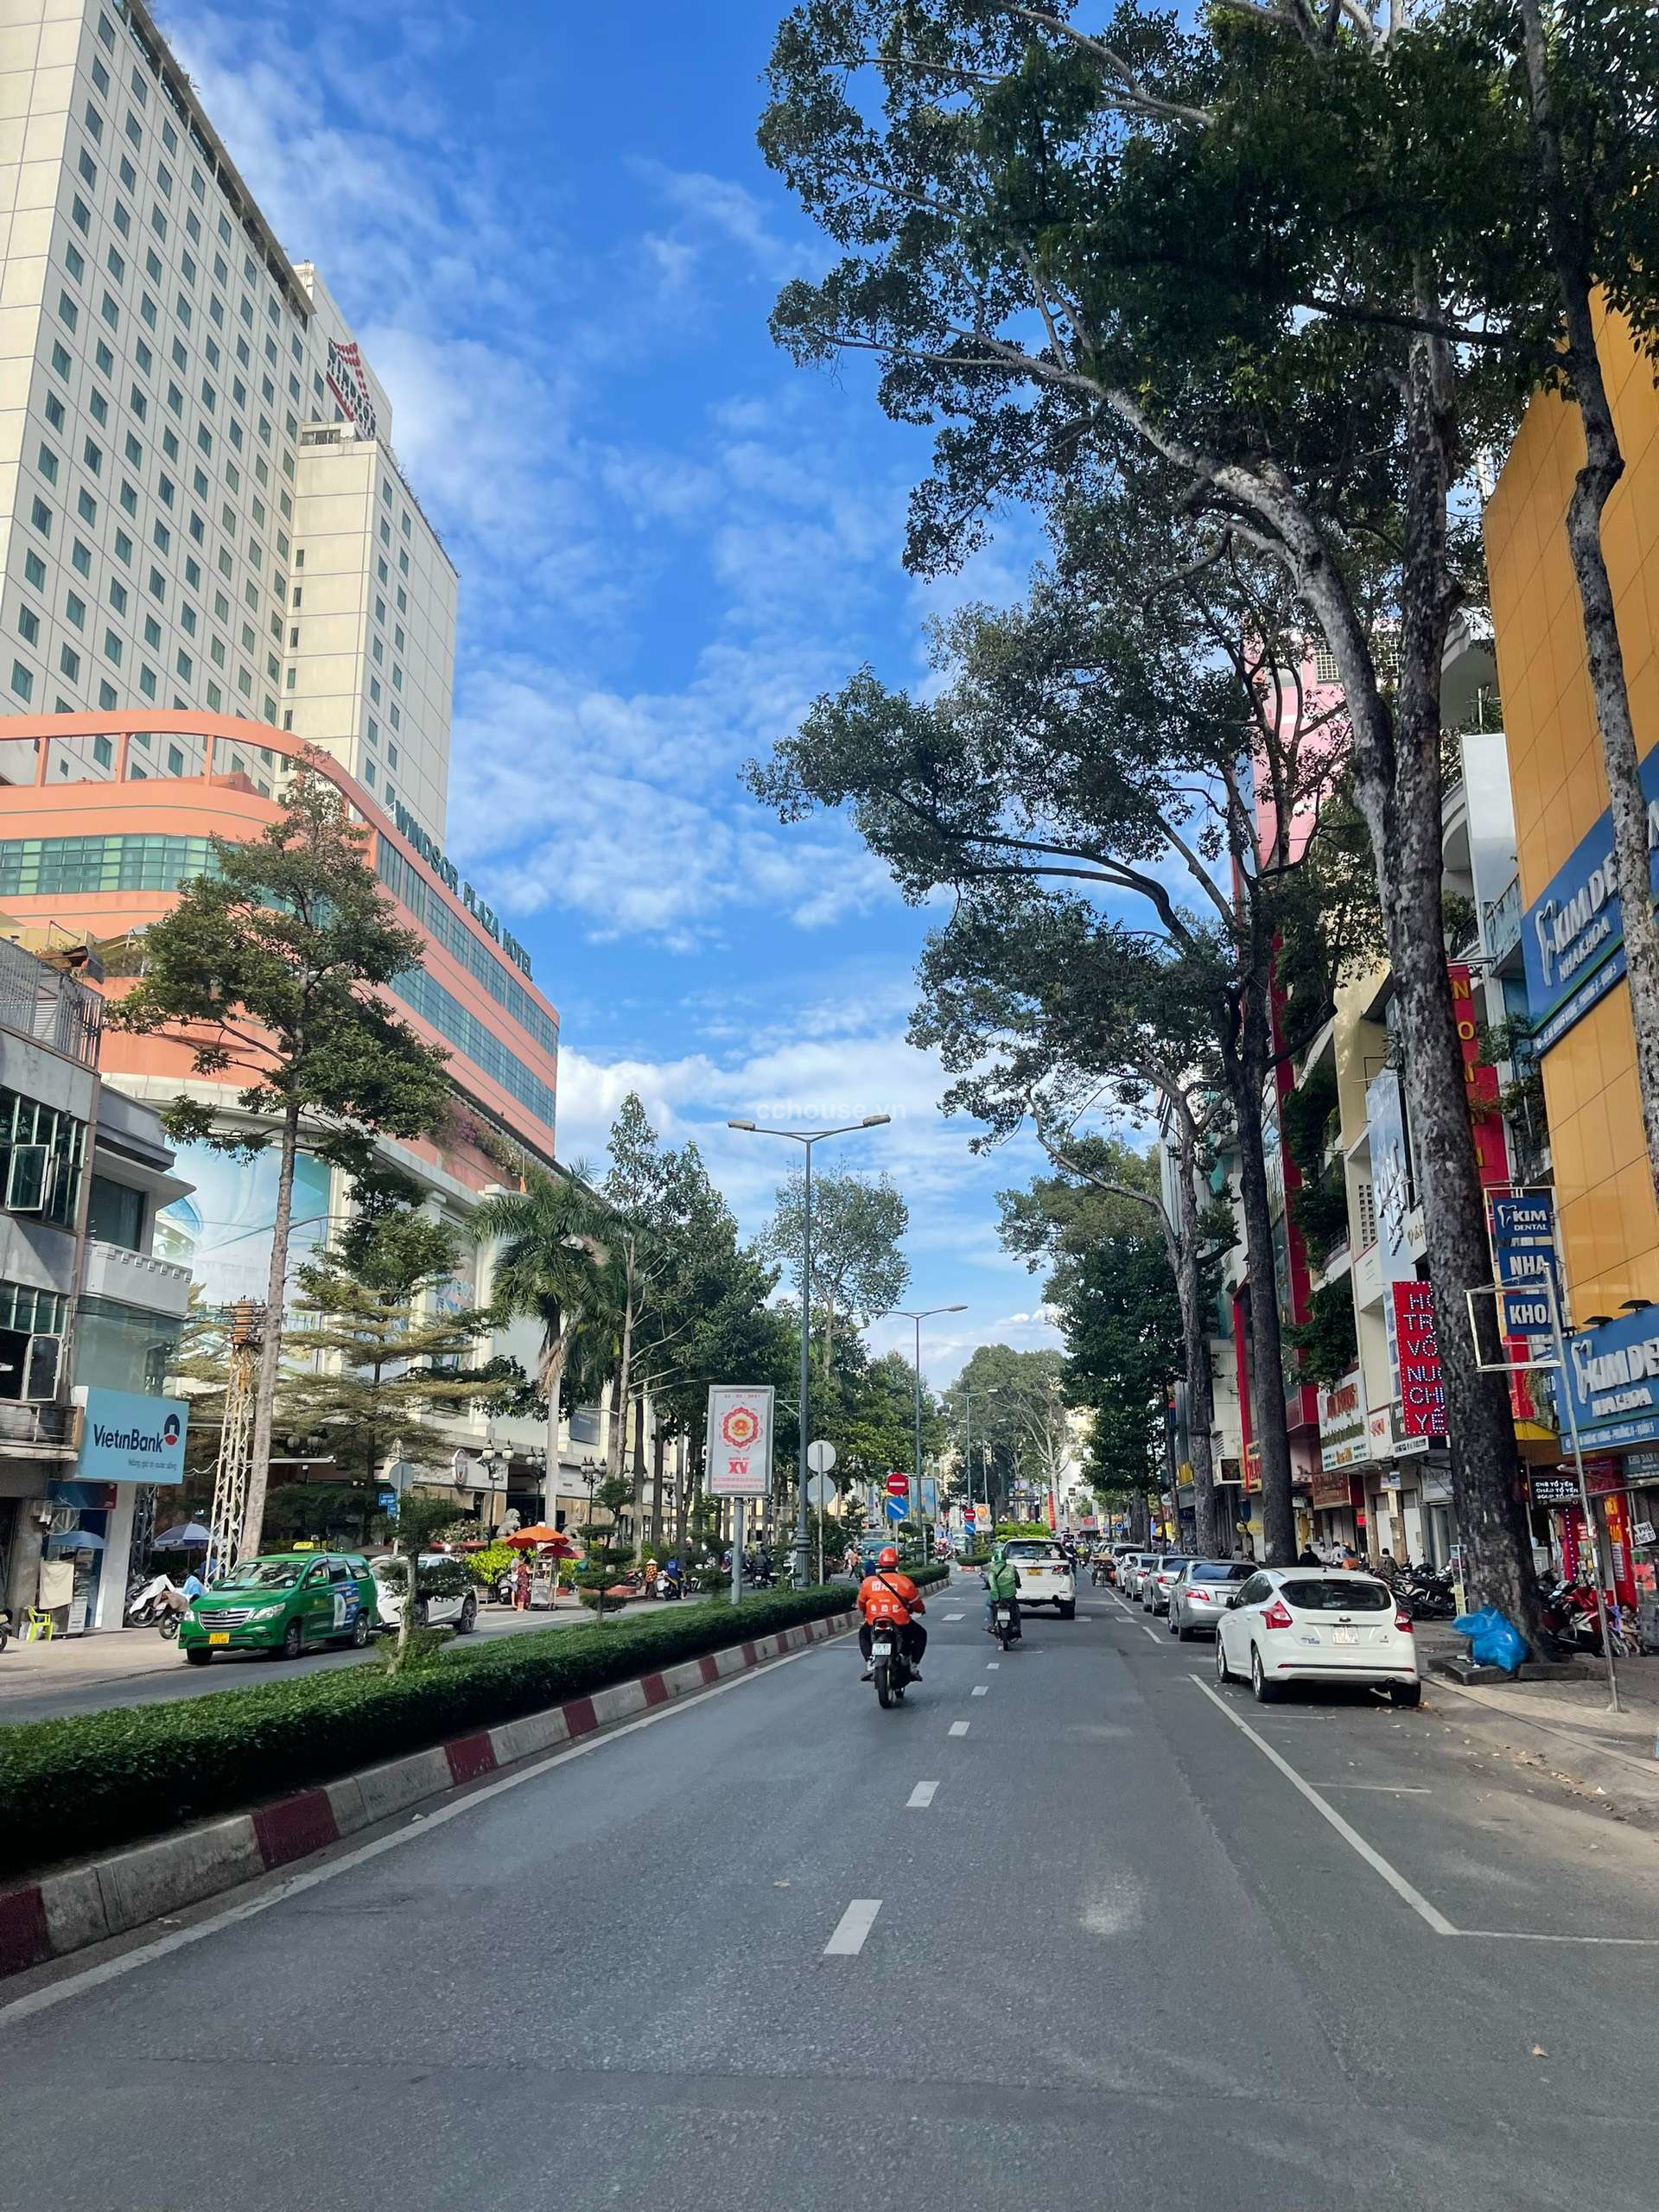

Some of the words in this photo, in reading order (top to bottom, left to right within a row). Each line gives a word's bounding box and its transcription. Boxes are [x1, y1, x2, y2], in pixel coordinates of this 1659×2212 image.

[395, 800, 459, 895] WINDSOR
[463, 881, 499, 944] PLAZA
[502, 928, 533, 981] HOTEL
[1512, 1211, 1548, 1223] KIM
[1510, 1255, 1548, 1276] NHA
[1403, 1314, 1434, 1331] TR
[1407, 1332, 1439, 1357] VỐ
[1626, 1337, 1659, 1382] DE
[1407, 1365, 1442, 1382] NU
[1409, 1387, 1444, 1404] CHI
[1414, 1405, 1446, 1430] YẾ
[93, 1423, 164, 1452] VietinBank
[728, 1461, 747, 1474] XV
